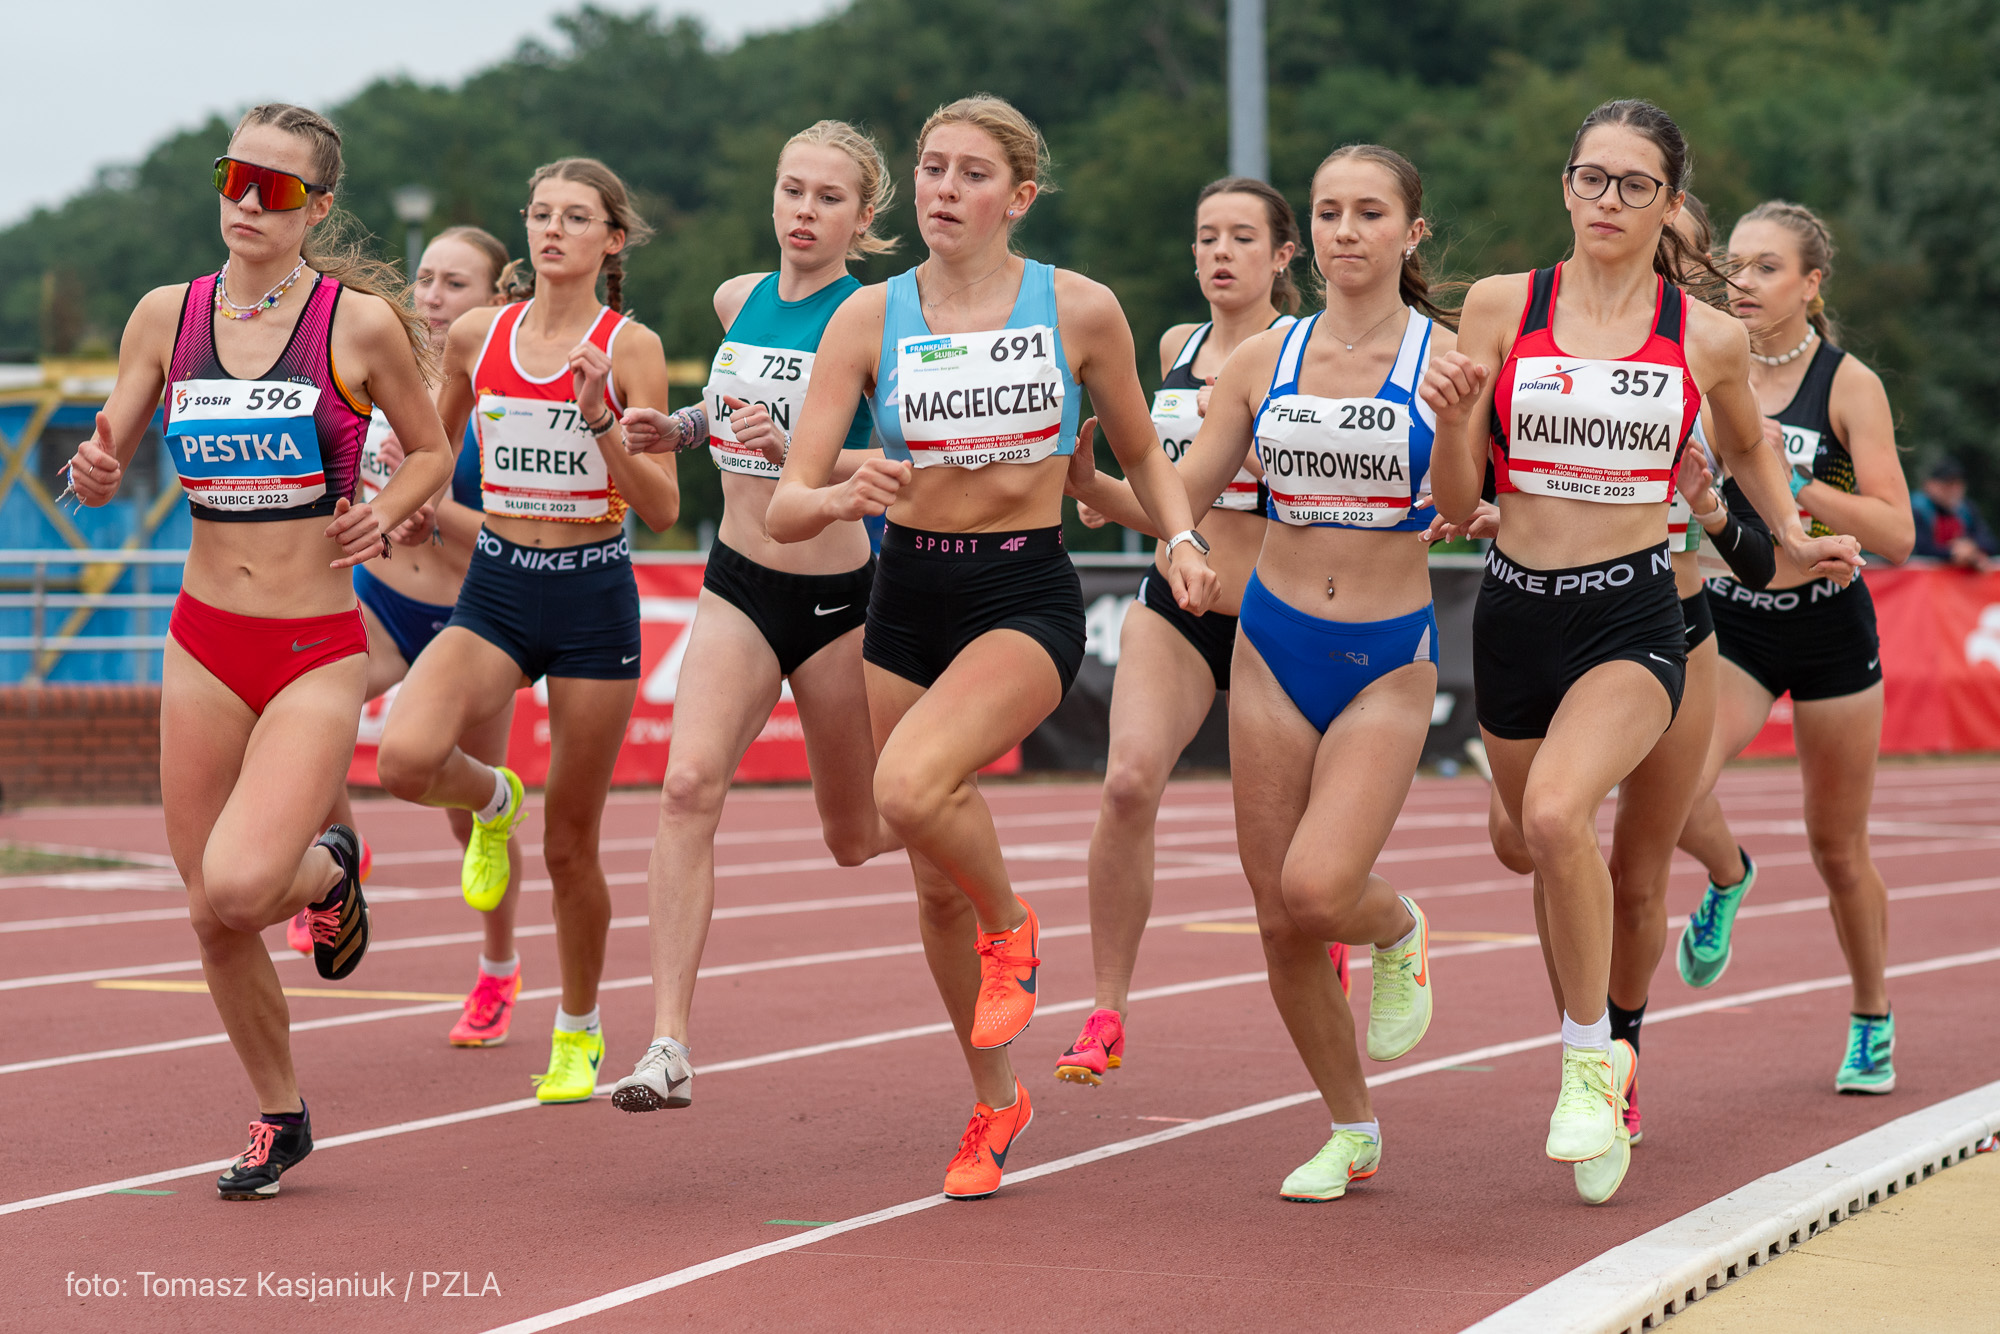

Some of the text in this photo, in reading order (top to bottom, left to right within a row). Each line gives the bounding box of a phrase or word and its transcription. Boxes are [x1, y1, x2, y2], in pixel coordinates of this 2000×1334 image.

[910, 343, 951, 353] FRANKFURT
[934, 350, 963, 359] SŁUBICE
[990, 332, 1046, 362] 691
[759, 354, 803, 381] 725
[1518, 380, 1561, 392] polanik
[1610, 369, 1669, 397] 357
[246, 387, 303, 411] 596
[905, 381, 1058, 423] MACIEICZEK
[1277, 408, 1322, 424] FUEL
[1338, 404, 1396, 431] 280
[960, 437, 995, 445] Mistrzostwa
[1517, 413, 1671, 453] KALINOWSKA
[179, 432, 303, 463] PESTKA
[972, 442, 998, 450] JANUSZA
[494, 446, 589, 476] GIEREK
[943, 448, 1031, 465] SŁUBICE 2023
[1262, 445, 1405, 482] PIOTROWSKA
[754, 460, 780, 472] 2023
[1549, 469, 1579, 478] MEMORIAŁ
[1579, 473, 1606, 481] JANUSZA
[1569, 465, 1603, 475] Mistrzostwa
[1546, 479, 1635, 497] SŁUBICE 2023
[207, 494, 289, 505] SŁUBICE 2023
[505, 499, 576, 512] SŁUBICE 2023
[1289, 510, 1374, 522] SŁUBICE 2023
[476, 529, 629, 571] RO NIKE PRO
[915, 535, 1028, 554] SPORT 4F
[1485, 547, 1672, 596] NIKE PRO NI
[1730, 586, 1800, 611] PRO
